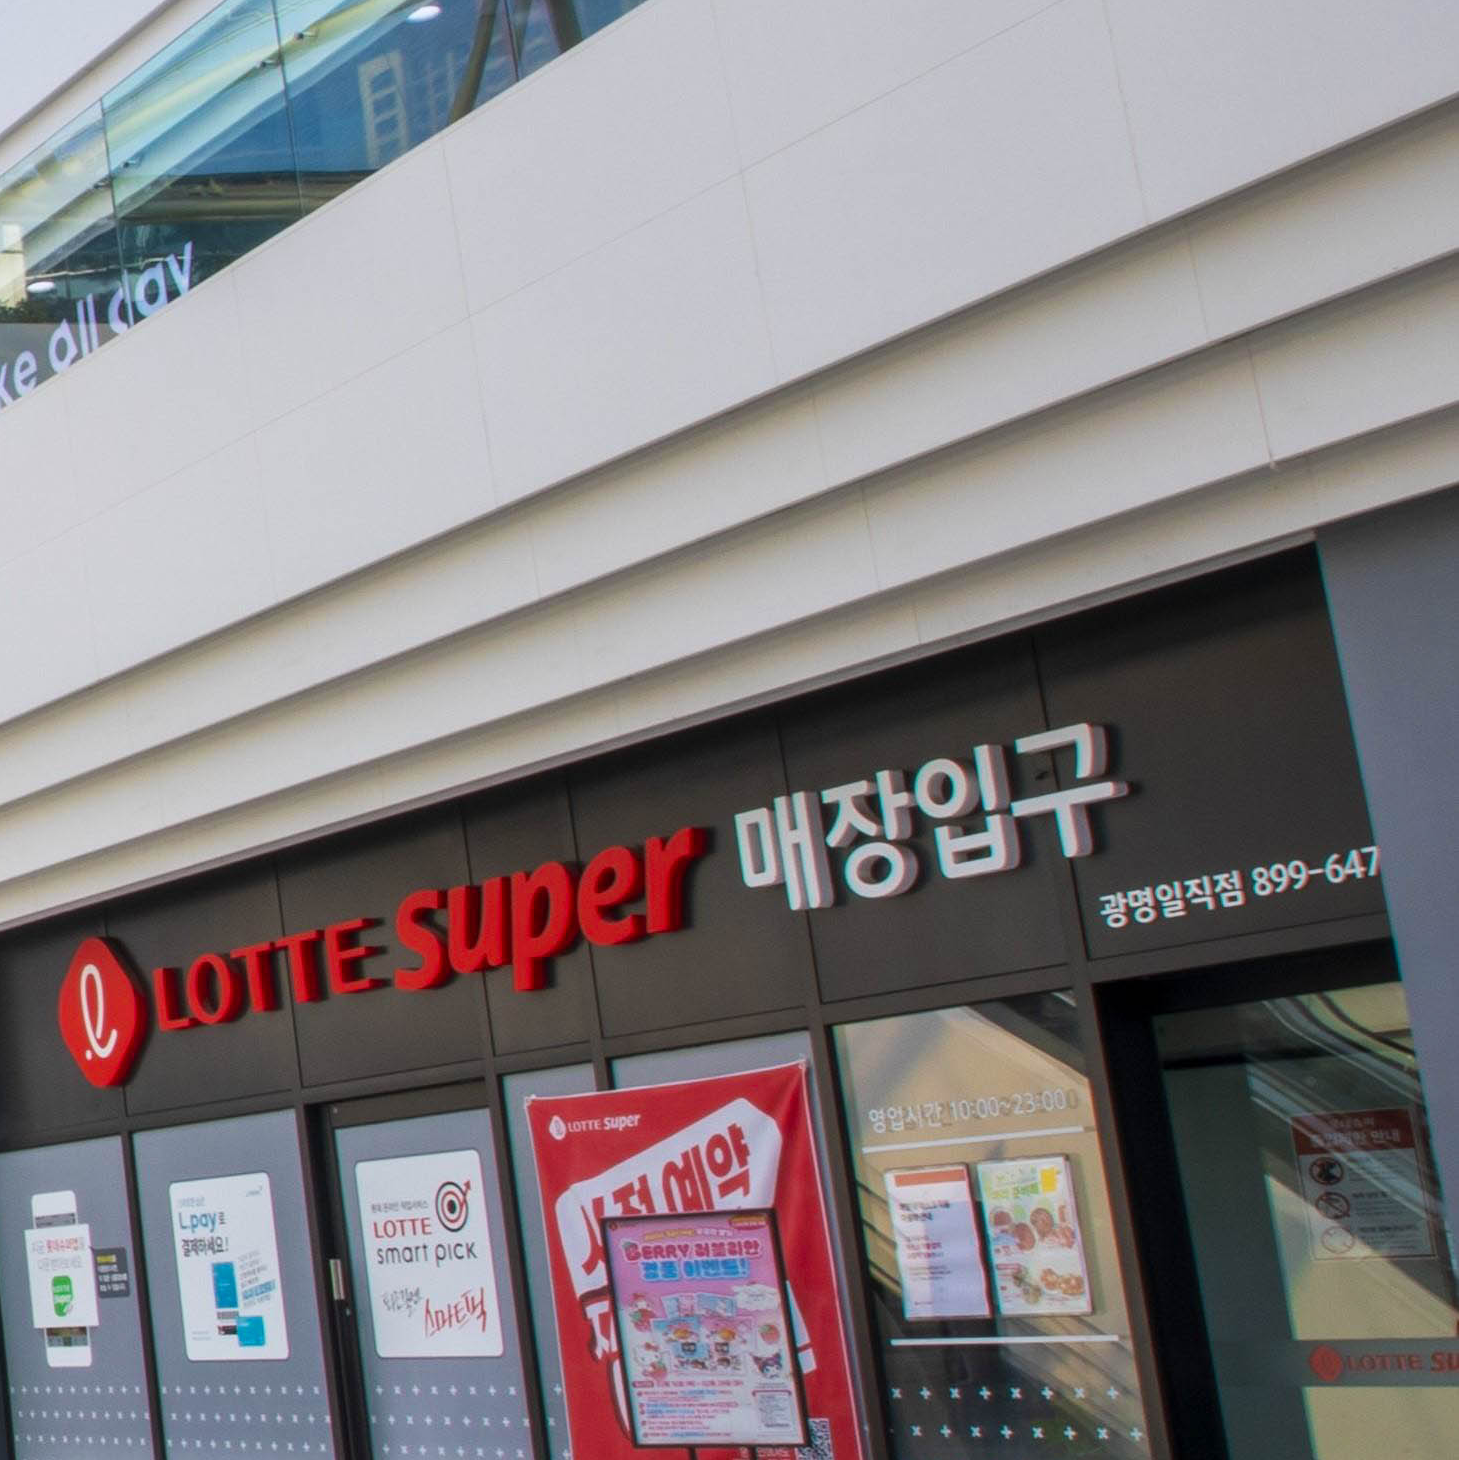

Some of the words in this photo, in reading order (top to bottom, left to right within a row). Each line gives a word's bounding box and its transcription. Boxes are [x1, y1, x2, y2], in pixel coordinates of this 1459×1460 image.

[49, 293, 99, 373] all
[733, 722, 1130, 911] 매장입구
[1099, 871, 1246, 929] 광명일직점
[153, 917, 383, 1031] LOTTE
[567, 1119, 601, 1132] LOTTE
[868, 1102, 943, 1134] 영업시간
[949, 1089, 1067, 1121] 10:00~23:00
[662, 1122, 751, 1210] 예약
[373, 1217, 433, 1239] LOTTE
[377, 1242, 428, 1265] smart
[434, 1241, 478, 1268] pick
[1347, 1352, 1423, 1372] LOTTE
